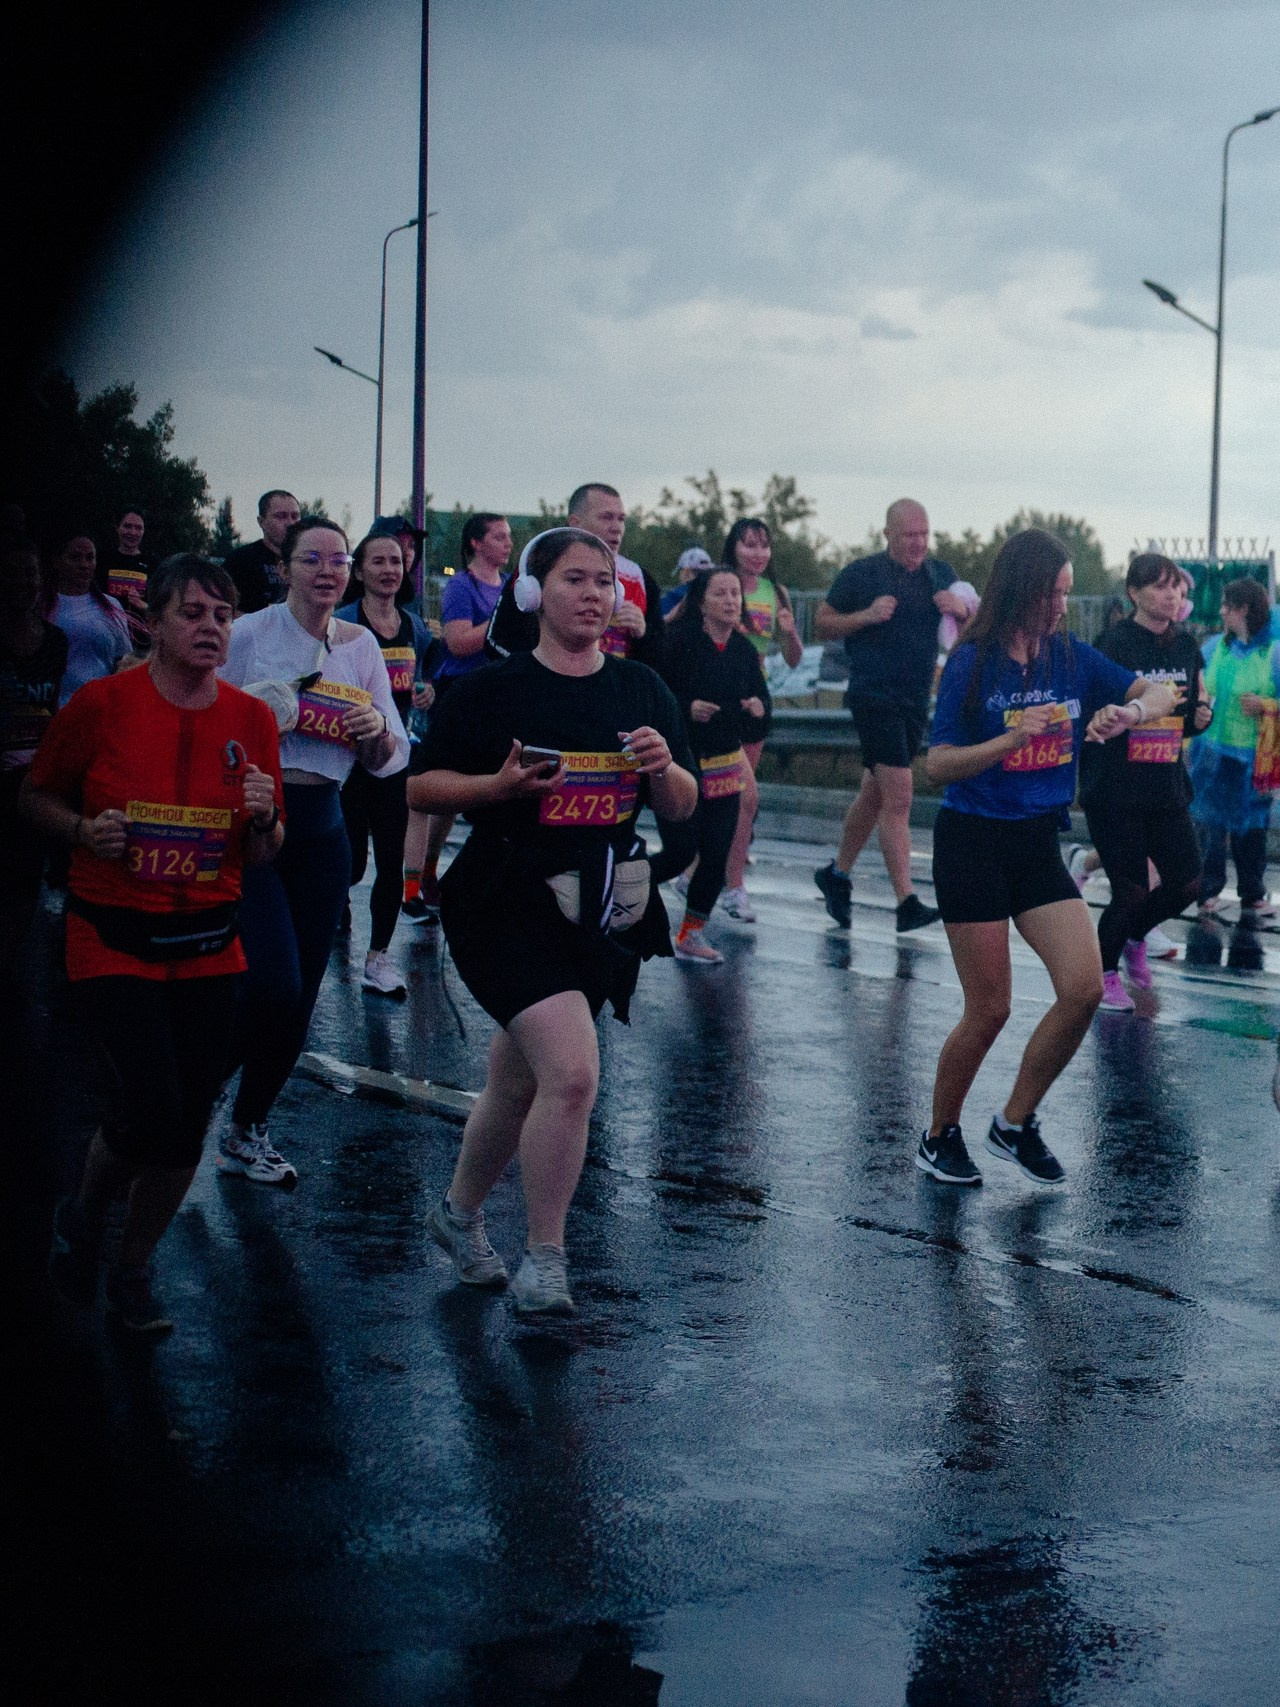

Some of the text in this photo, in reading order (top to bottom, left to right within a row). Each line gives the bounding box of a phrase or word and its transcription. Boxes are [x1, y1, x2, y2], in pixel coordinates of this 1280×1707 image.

[315, 681, 341, 694] ЧНОЙ
[1009, 743, 1058, 767] 3166
[130, 804, 229, 825] НОЧНОЙ ЗАБЕГ
[546, 794, 616, 820] 2473
[127, 845, 197, 876] 3126
